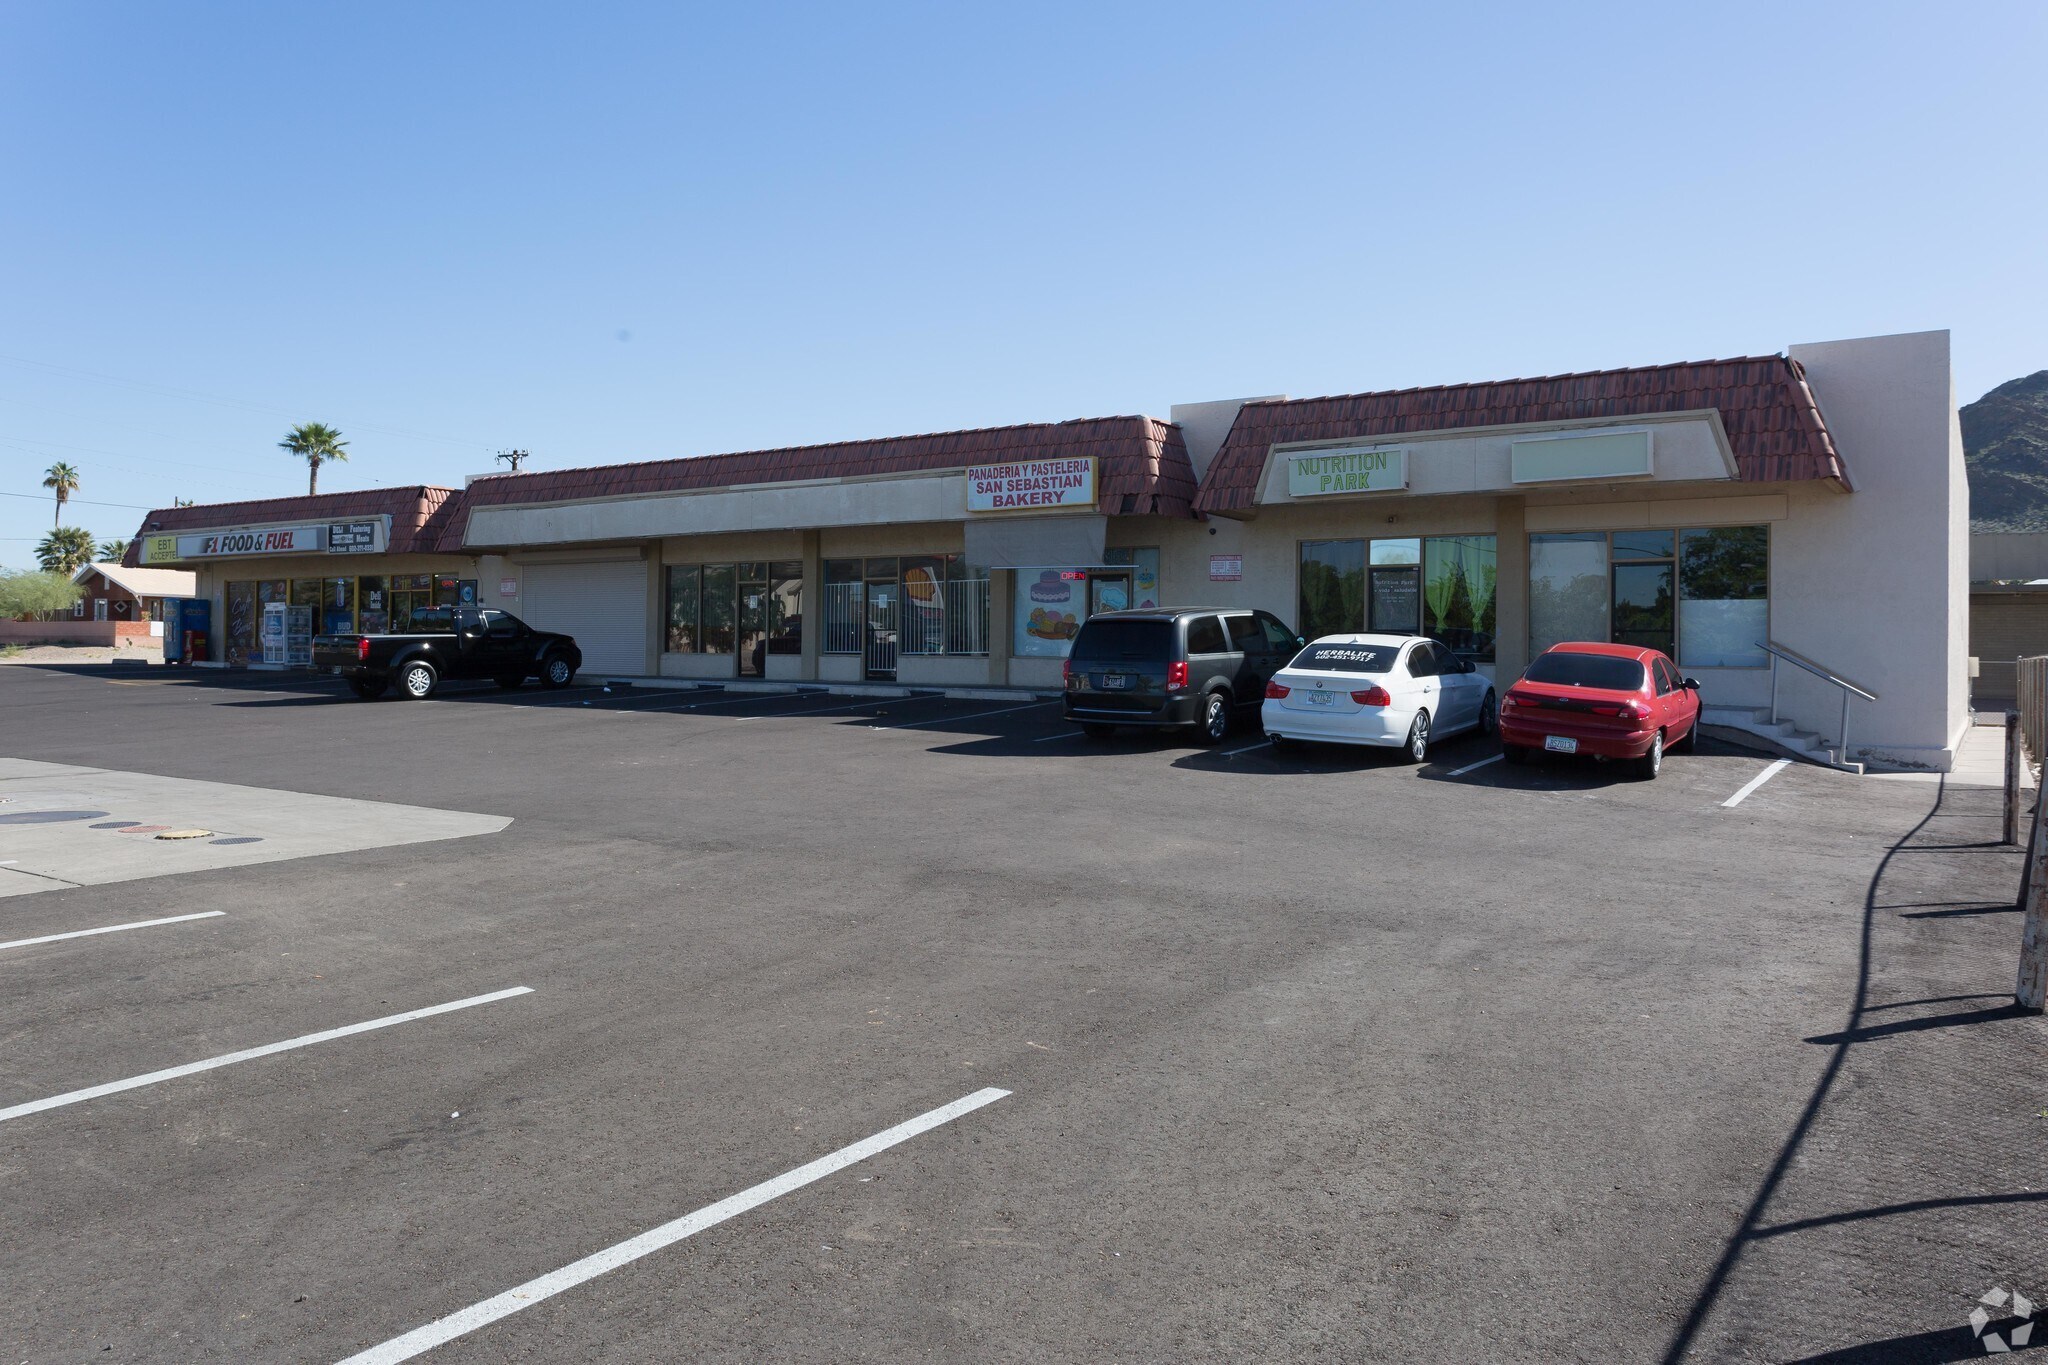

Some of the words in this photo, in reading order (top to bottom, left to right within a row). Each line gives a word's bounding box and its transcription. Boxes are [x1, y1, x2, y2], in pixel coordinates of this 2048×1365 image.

[968, 466, 1020, 481] PANADERIA
[1022, 465, 1029, 477] Y
[1031, 459, 1090, 477] PASTELERIA
[1298, 452, 1387, 476] NUTRITION
[976, 481, 1003, 494] SAN
[1006, 474, 1083, 492] SEBASTIAN
[1320, 472, 1370, 492] PARK
[992, 490, 1065, 508] BAKERY
[157, 539, 171, 550] EBT
[221, 535, 253, 552] FOOD
[254, 534, 263, 551] &
[265, 532, 294, 551] FUEL
[150, 551, 178, 560] ACCEPTE
[1061, 571, 1085, 580] OPEN
[337, 621, 351, 630] BUD
[1315, 650, 1376, 659] HERBALIFE
